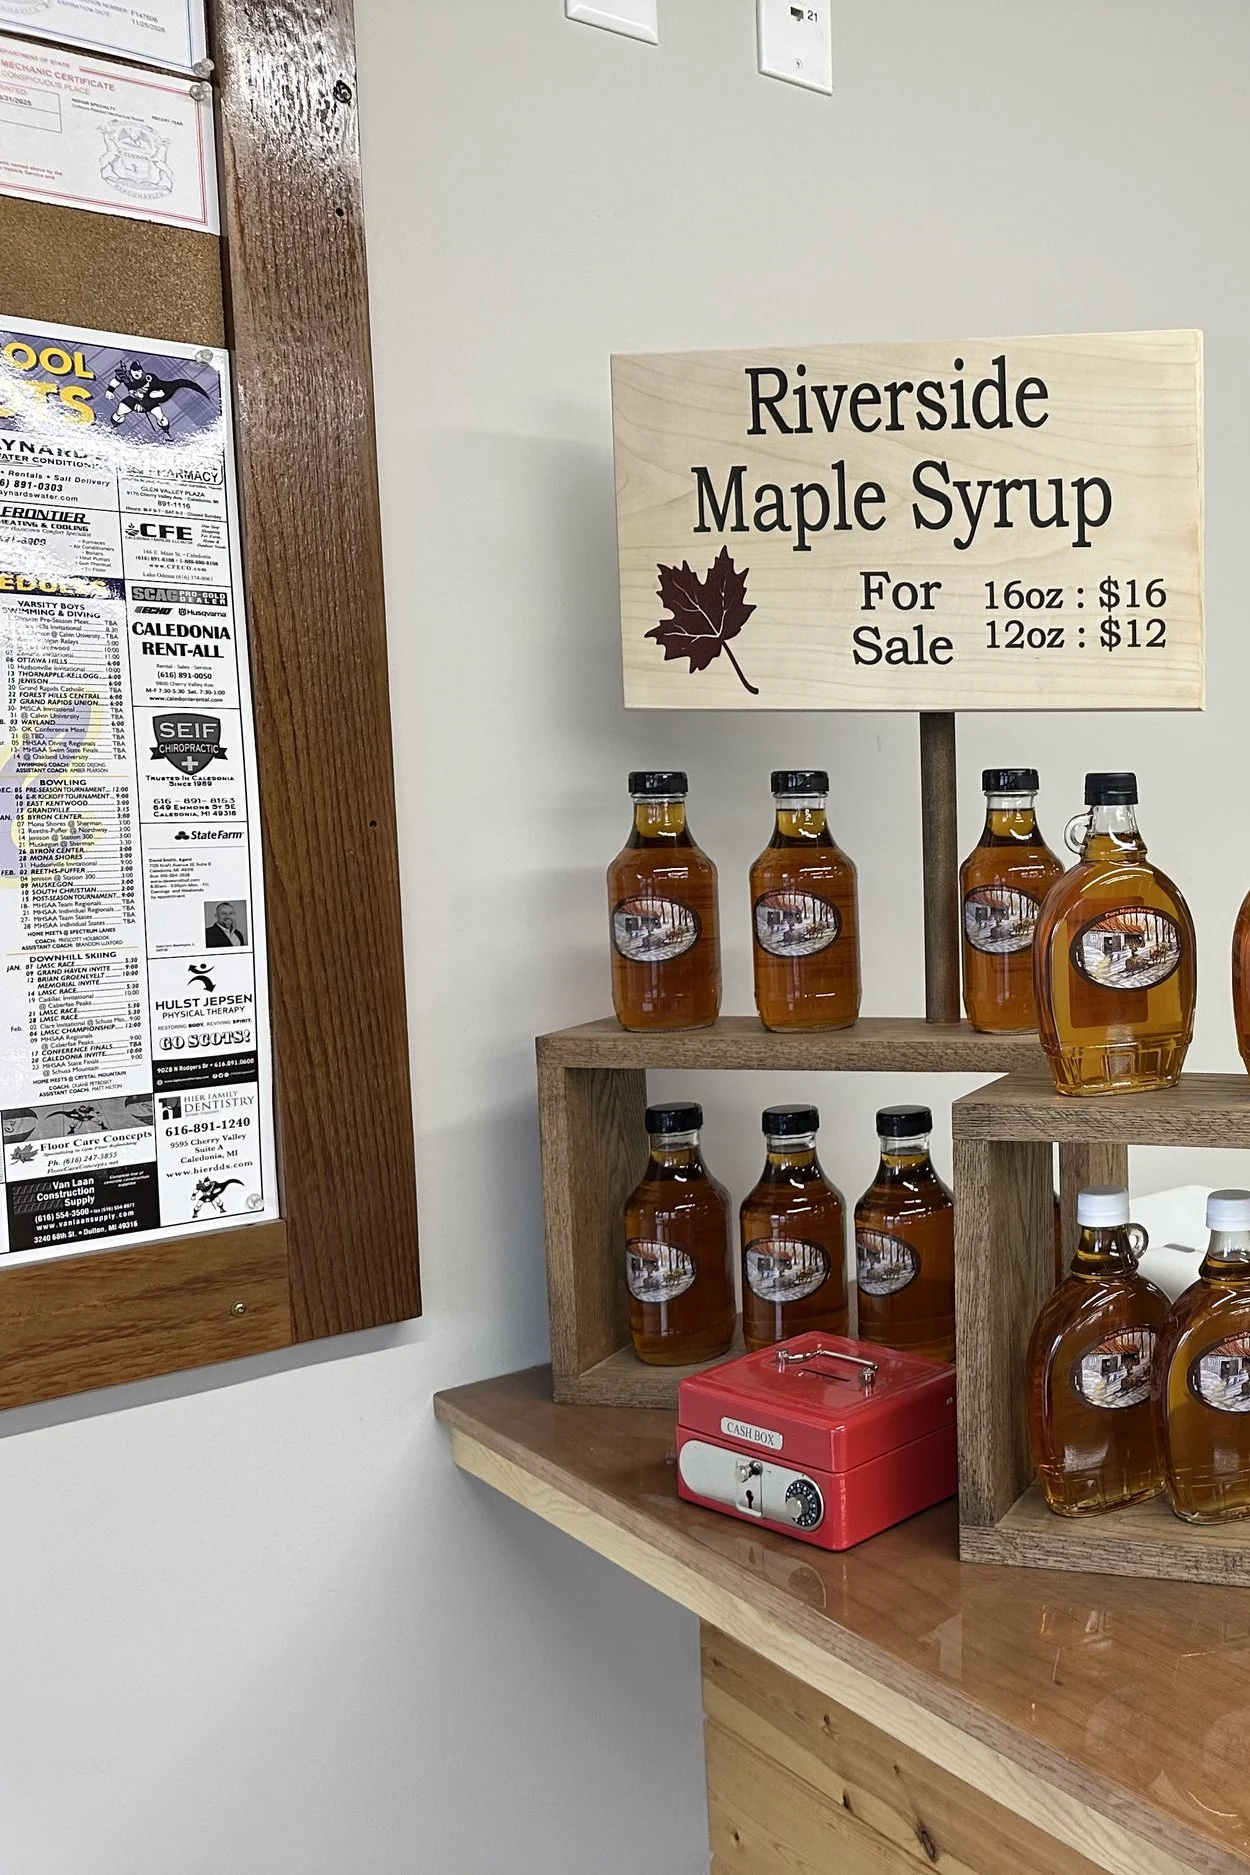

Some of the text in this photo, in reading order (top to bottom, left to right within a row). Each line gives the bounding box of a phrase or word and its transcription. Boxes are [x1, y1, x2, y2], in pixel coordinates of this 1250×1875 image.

[807, 10, 818, 22] 21
[1, 60, 115, 91] MECHANIC CERTIFICATE
[64, 83, 90, 95] PLACE
[744, 354, 1050, 436] Riverside
[8, 470, 110, 487] Rentals Salt Delivery
[14, 480, 63, 492] 891-0303
[158, 500, 191, 509] 891-1116
[690, 459, 1113, 551] Maple Syrup
[2, 506, 86, 523] FRONTIER
[51, 523, 89, 532] COOLING
[140, 522, 193, 541] CFE
[132, 587, 226, 602] SCAG PRO-GOLD
[859, 571, 943, 611] For
[984, 580, 1064, 611] 16oz
[1098, 575, 1167, 612] $16
[17, 600, 85, 610] VARSITY BOYS
[180, 596, 226, 605] DEALER
[67, 611, 101, 619] DIVING
[141, 606, 227, 617] ECHO Husqvarna
[132, 621, 231, 640] CALEDONIA
[985, 619, 1065, 650] 12oz
[1098, 615, 1167, 651] $12
[142, 641, 225, 659] RENT-ALL
[852, 624, 954, 666] Sale
[18, 670, 99, 680] THORNAPPLE-KELLOGG
[157, 671, 212, 680] (616) 891-0050
[160, 722, 218, 738] SEIF
[159, 743, 219, 754] CHIROPRACTIC
[29, 951, 117, 963] DOWNHILL SKIING
[155, 994, 253, 1011] HULST JEPSEN
[162, 1006, 246, 1019] PHYSICAL THERAPY
[159, 1029, 251, 1051] GO SCOTS!
[184, 1090, 239, 1103] HIER FAMILY
[184, 1095, 255, 1113] DENTISTRY
[165, 1117, 251, 1137] 616-891-1240
[40, 1141, 70, 1152] Floor
[73, 1138, 100, 1147] Care
[103, 1131, 153, 1143] Concepts
[170, 1133, 247, 1149] 9595 Cherry Valley
[180, 1149, 239, 1164] Caledonia, MI
[194, 1146, 216, 1154] Suite
[47, 1151, 118, 1167] Ph. (616) 247-3855
[166, 1160, 253, 1178] www.hierdds.com
[53, 1180, 70, 1190] Van
[72, 1177, 95, 1187] Laan
[36, 1186, 95, 1202] Construction
[64, 1195, 95, 1207] Supply
[35, 1212, 55, 1224] (616)
[55, 1208, 89, 1220] 554-3500
[36, 1210, 135, 1231] www.vanlaansupply.com
[33, 1234, 51, 1244] 3240
[727, 1421, 774, 1446] CASH BOX
